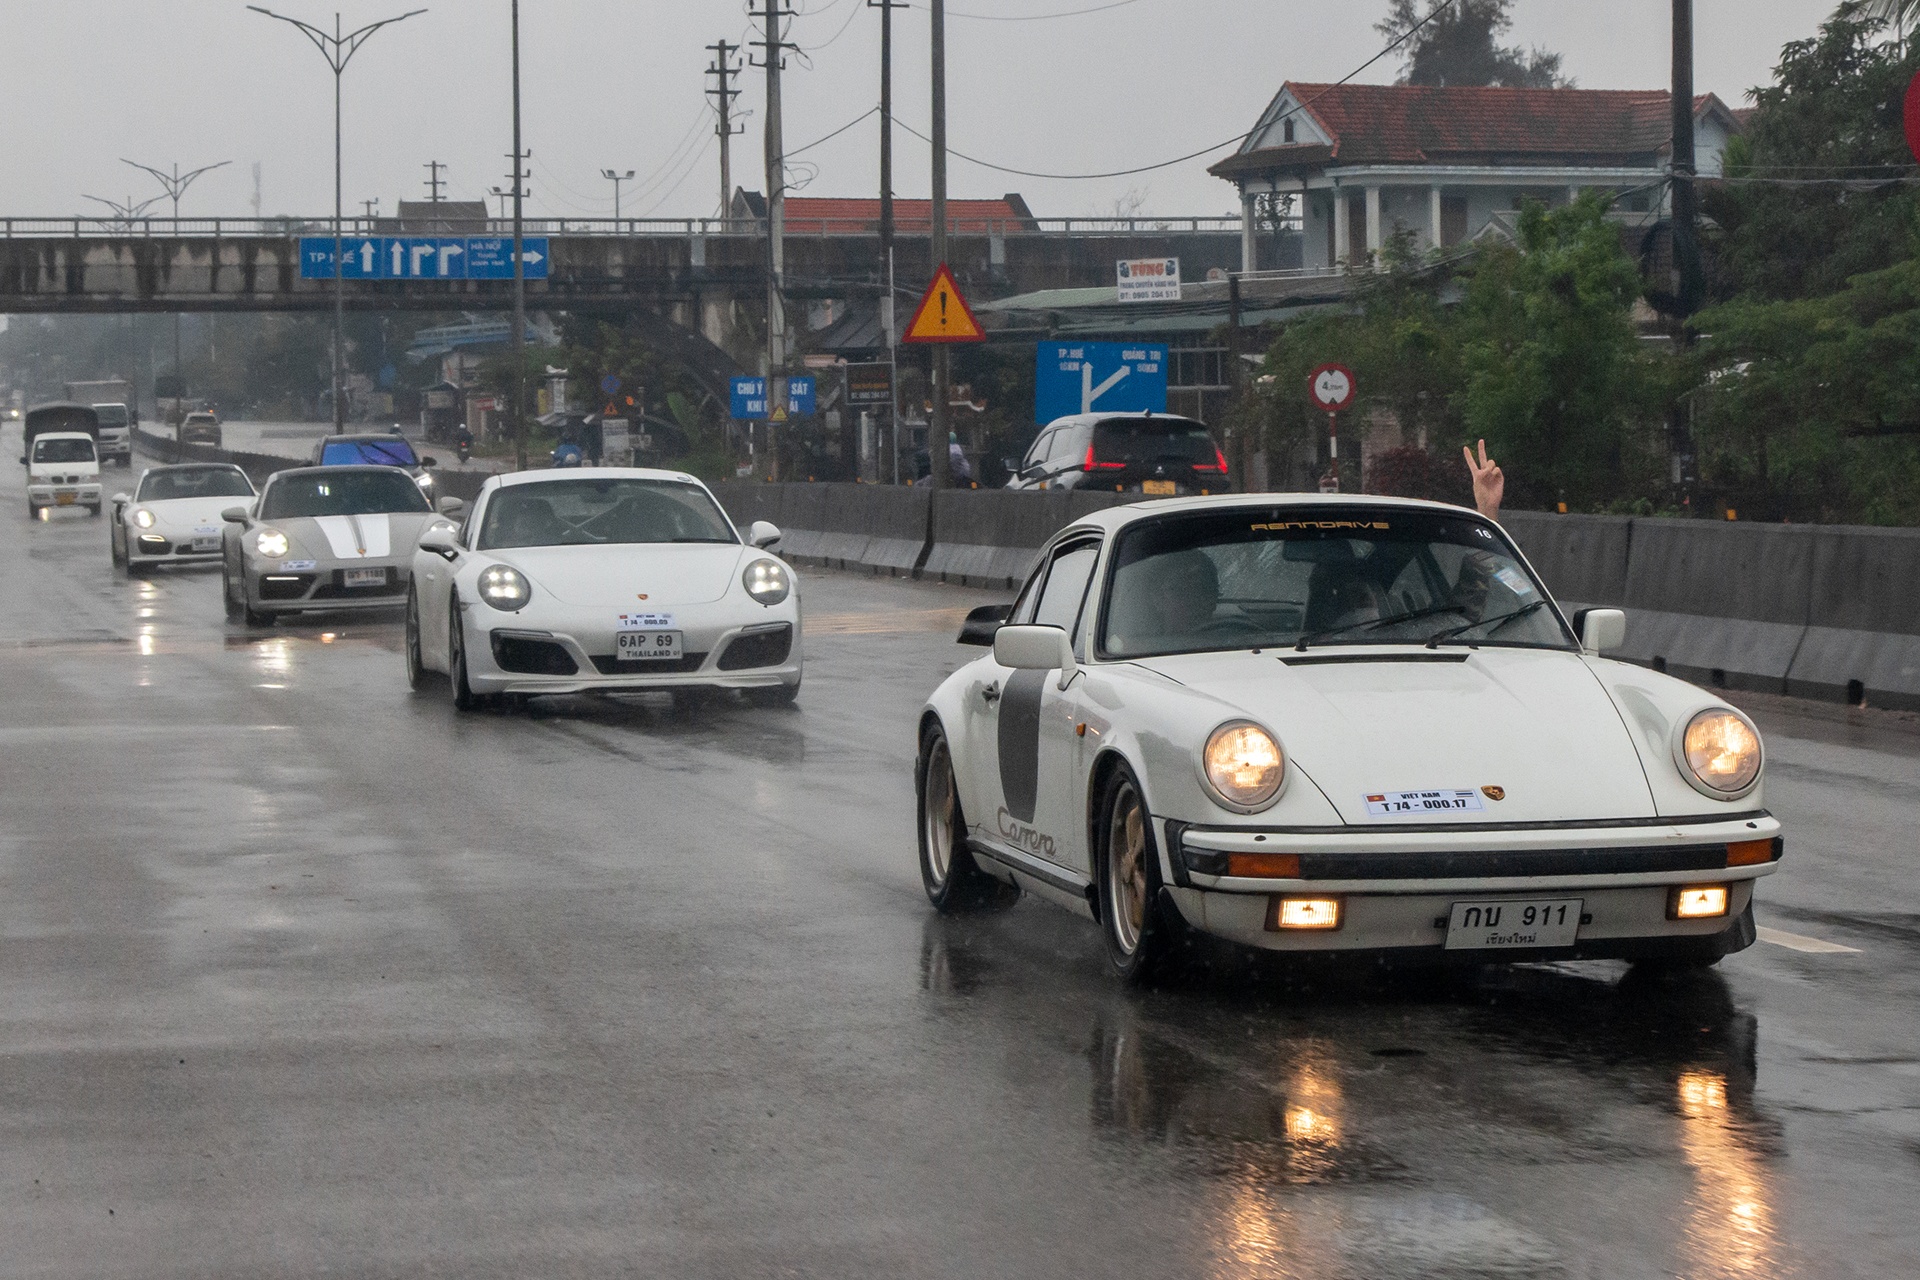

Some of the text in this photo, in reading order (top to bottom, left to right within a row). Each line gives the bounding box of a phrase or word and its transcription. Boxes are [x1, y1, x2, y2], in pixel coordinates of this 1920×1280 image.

[309, 252, 326, 263] TP
[790, 380, 808, 396] SÁT
[747, 400, 762, 412] KHI
[1250, 521, 1390, 532] RENNDRIVE
[1474, 528, 1492, 539] 16
[619, 635, 673, 648] 6AP 69
[1381, 803, 1390, 812] T
[1393, 801, 1411, 811] 74
[1423, 798, 1467, 809] 000.17
[997, 805, 1057, 857] Carrera
[1522, 904, 1567, 926] 911
[1485, 931, 1537, 945] เชียงใหม่
